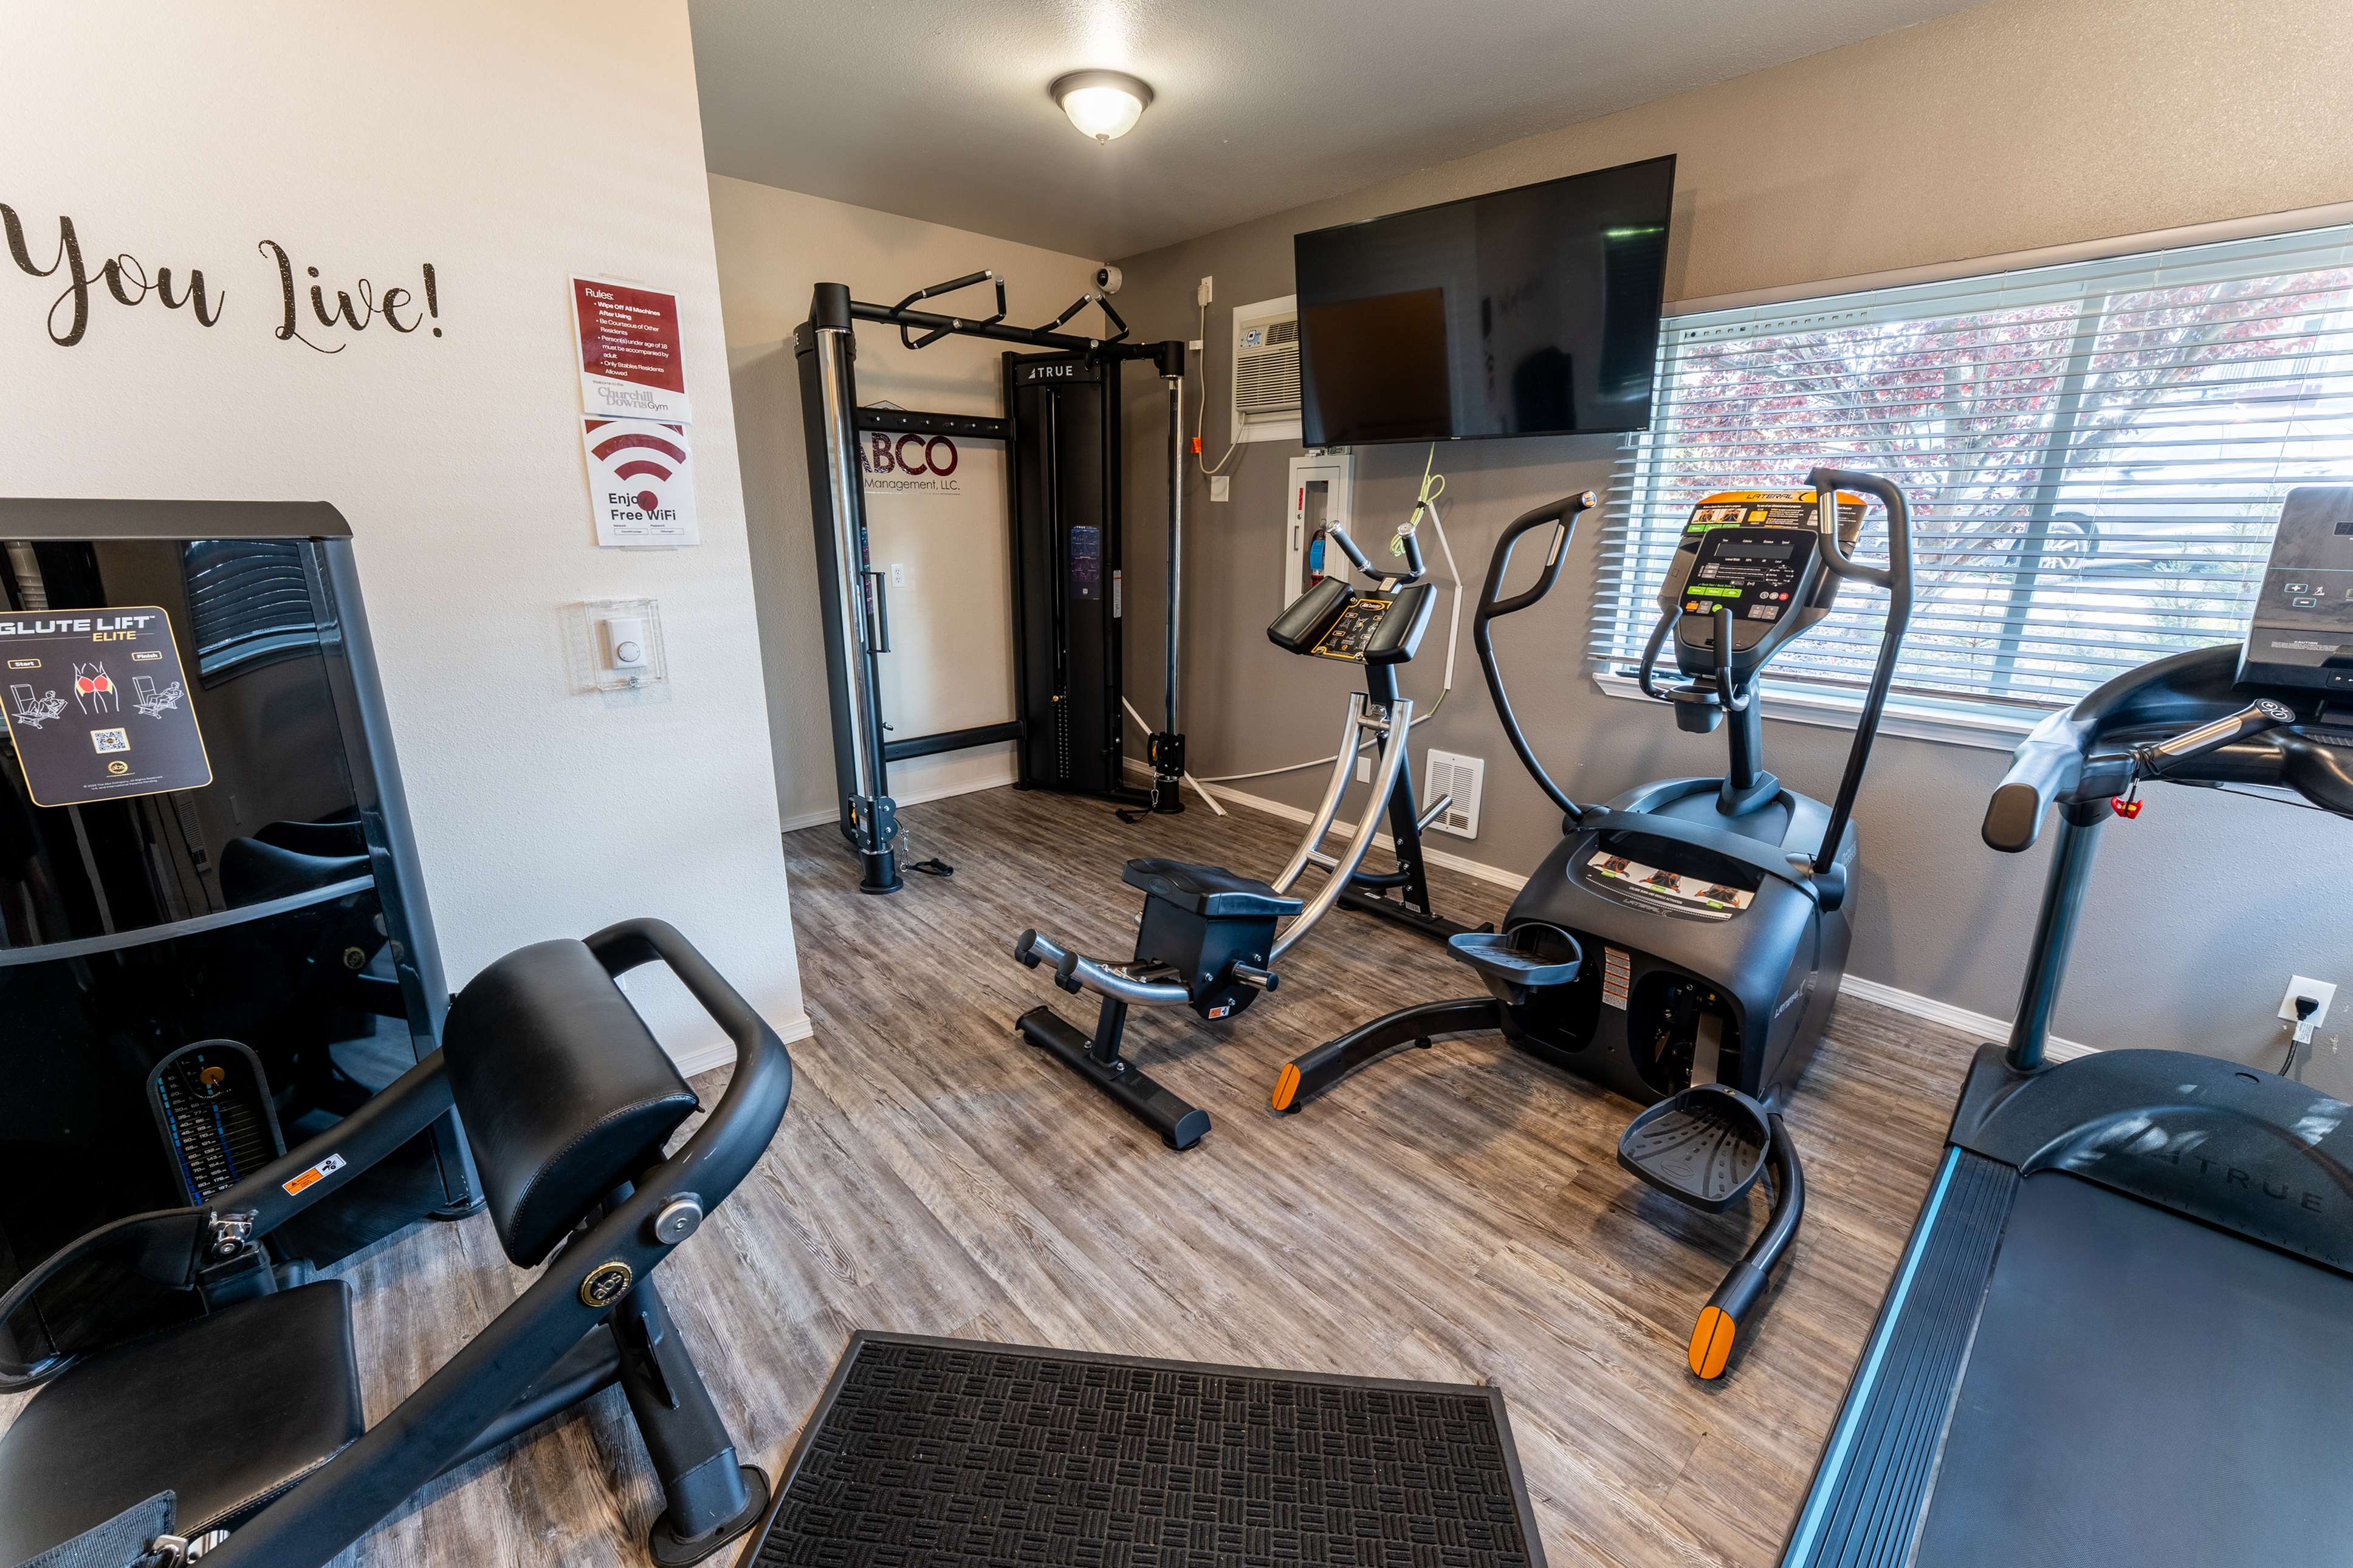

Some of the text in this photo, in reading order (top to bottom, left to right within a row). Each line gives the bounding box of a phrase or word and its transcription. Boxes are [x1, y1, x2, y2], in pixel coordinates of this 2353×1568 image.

[0, 203, 442, 354] You Live!
[585, 288, 614, 300] Rules:
[615, 312, 631, 321] Using
[633, 307, 661, 316] Machines
[608, 320, 637, 329] Courteous
[600, 327, 628, 335] Residents
[601, 335, 627, 344] Person(s)
[625, 348, 661, 357] accompanied
[1037, 366, 1073, 378] TRUE
[598, 386, 654, 402] Churchill
[606, 395, 668, 411] Downs Gym
[864, 478, 961, 491] Management, LLC.
[611, 509, 676, 521] Free WiFi
[0, 618, 91, 635] GLUTE
[92, 631, 137, 642] ELITE
[593, 1273, 622, 1299] abs
